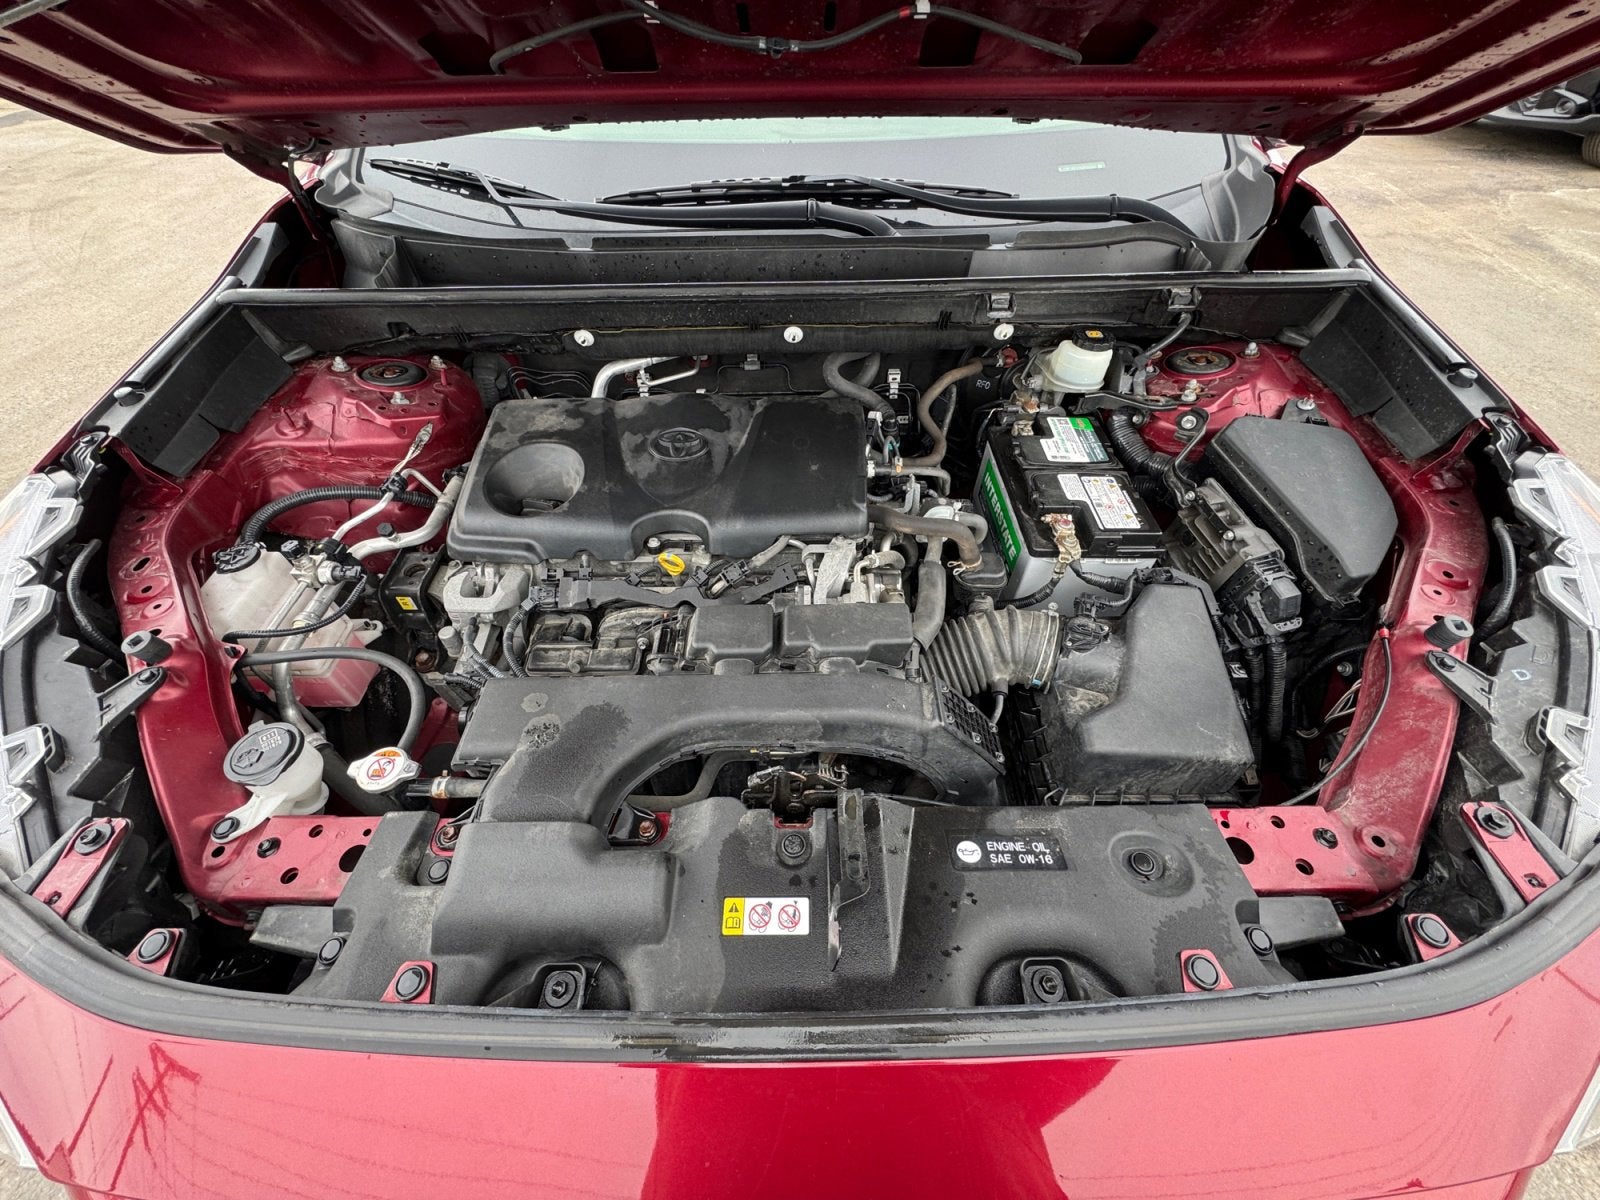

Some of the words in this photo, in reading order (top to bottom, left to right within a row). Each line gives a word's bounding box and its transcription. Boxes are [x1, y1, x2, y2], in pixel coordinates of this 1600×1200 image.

[984, 471, 1018, 561] INTERSTATE
[986, 841, 1027, 852] ENGINE
[1031, 842, 1050, 853] OIL
[989, 853, 1013, 864] SAE
